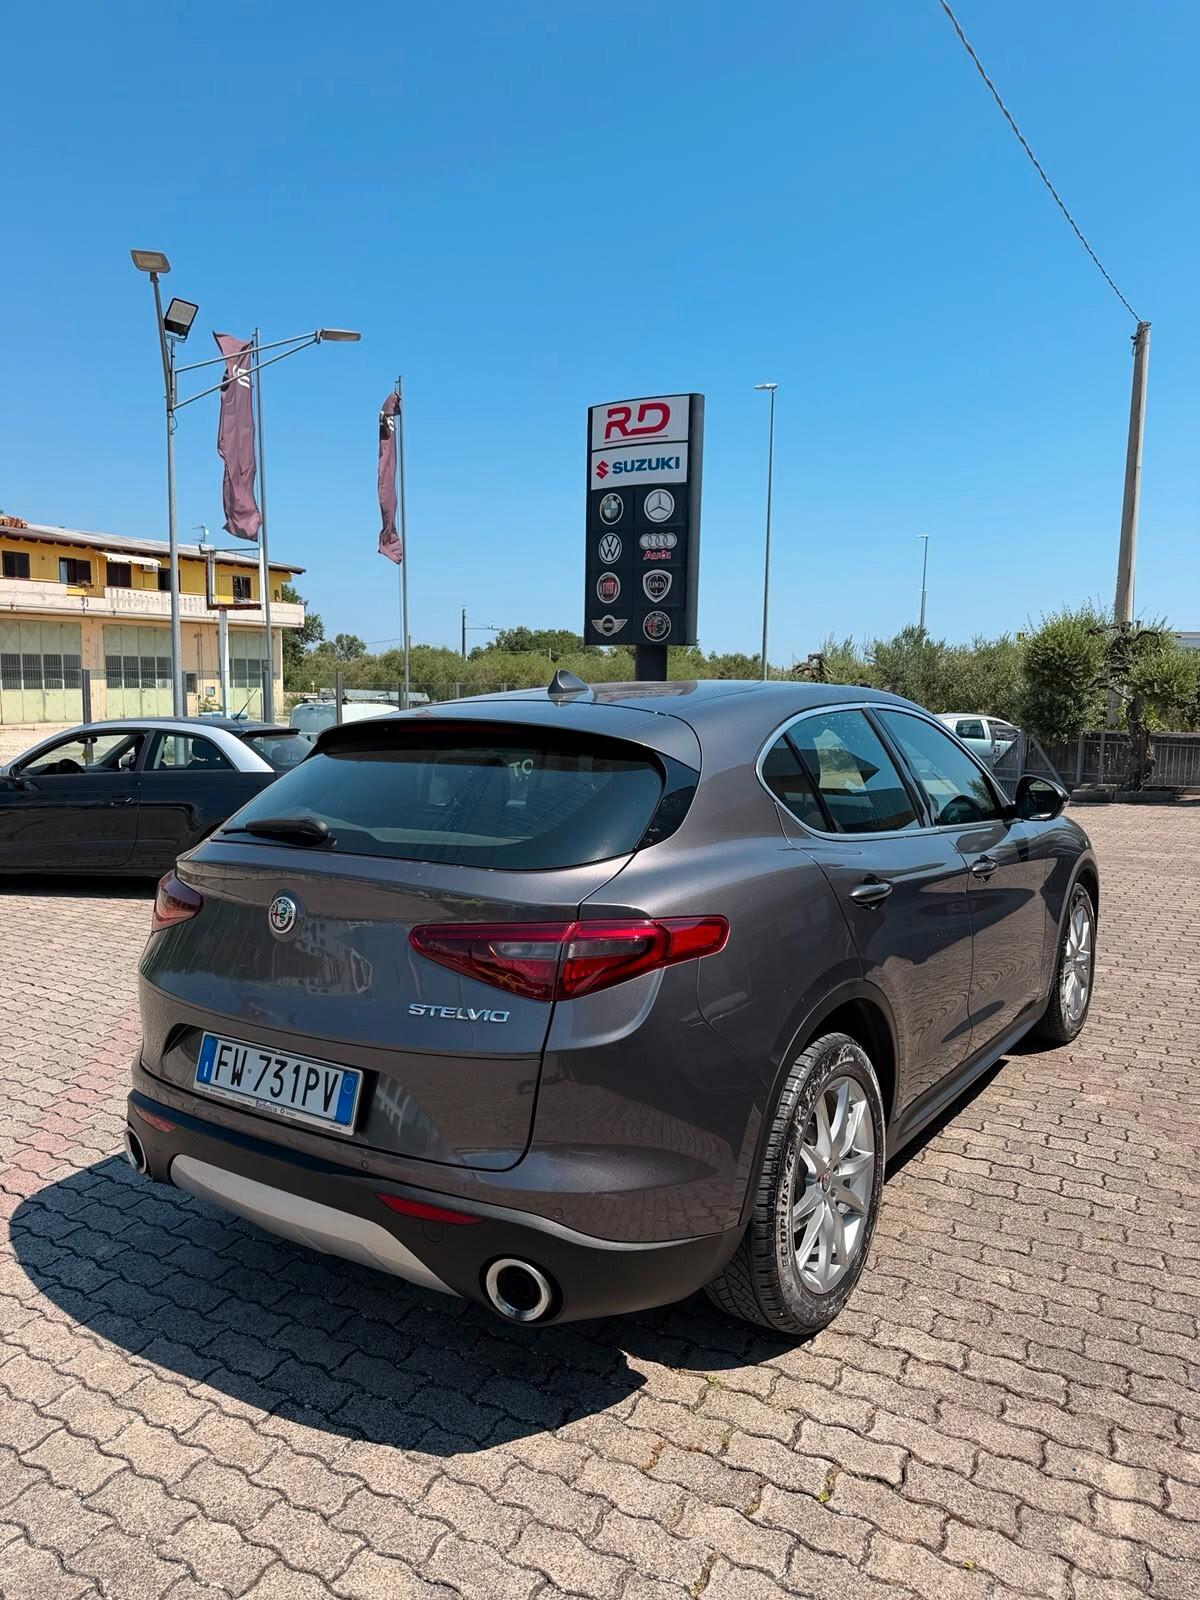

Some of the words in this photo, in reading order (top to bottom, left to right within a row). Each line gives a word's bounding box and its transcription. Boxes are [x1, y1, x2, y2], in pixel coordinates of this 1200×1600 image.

[605, 402, 671, 440] RD
[612, 456, 680, 475] SUZUKI
[643, 549, 671, 560] Audi
[408, 1003, 510, 1022] STELVIO
[214, 1044, 248, 1087] FW
[253, 1055, 339, 1113] 731PV
